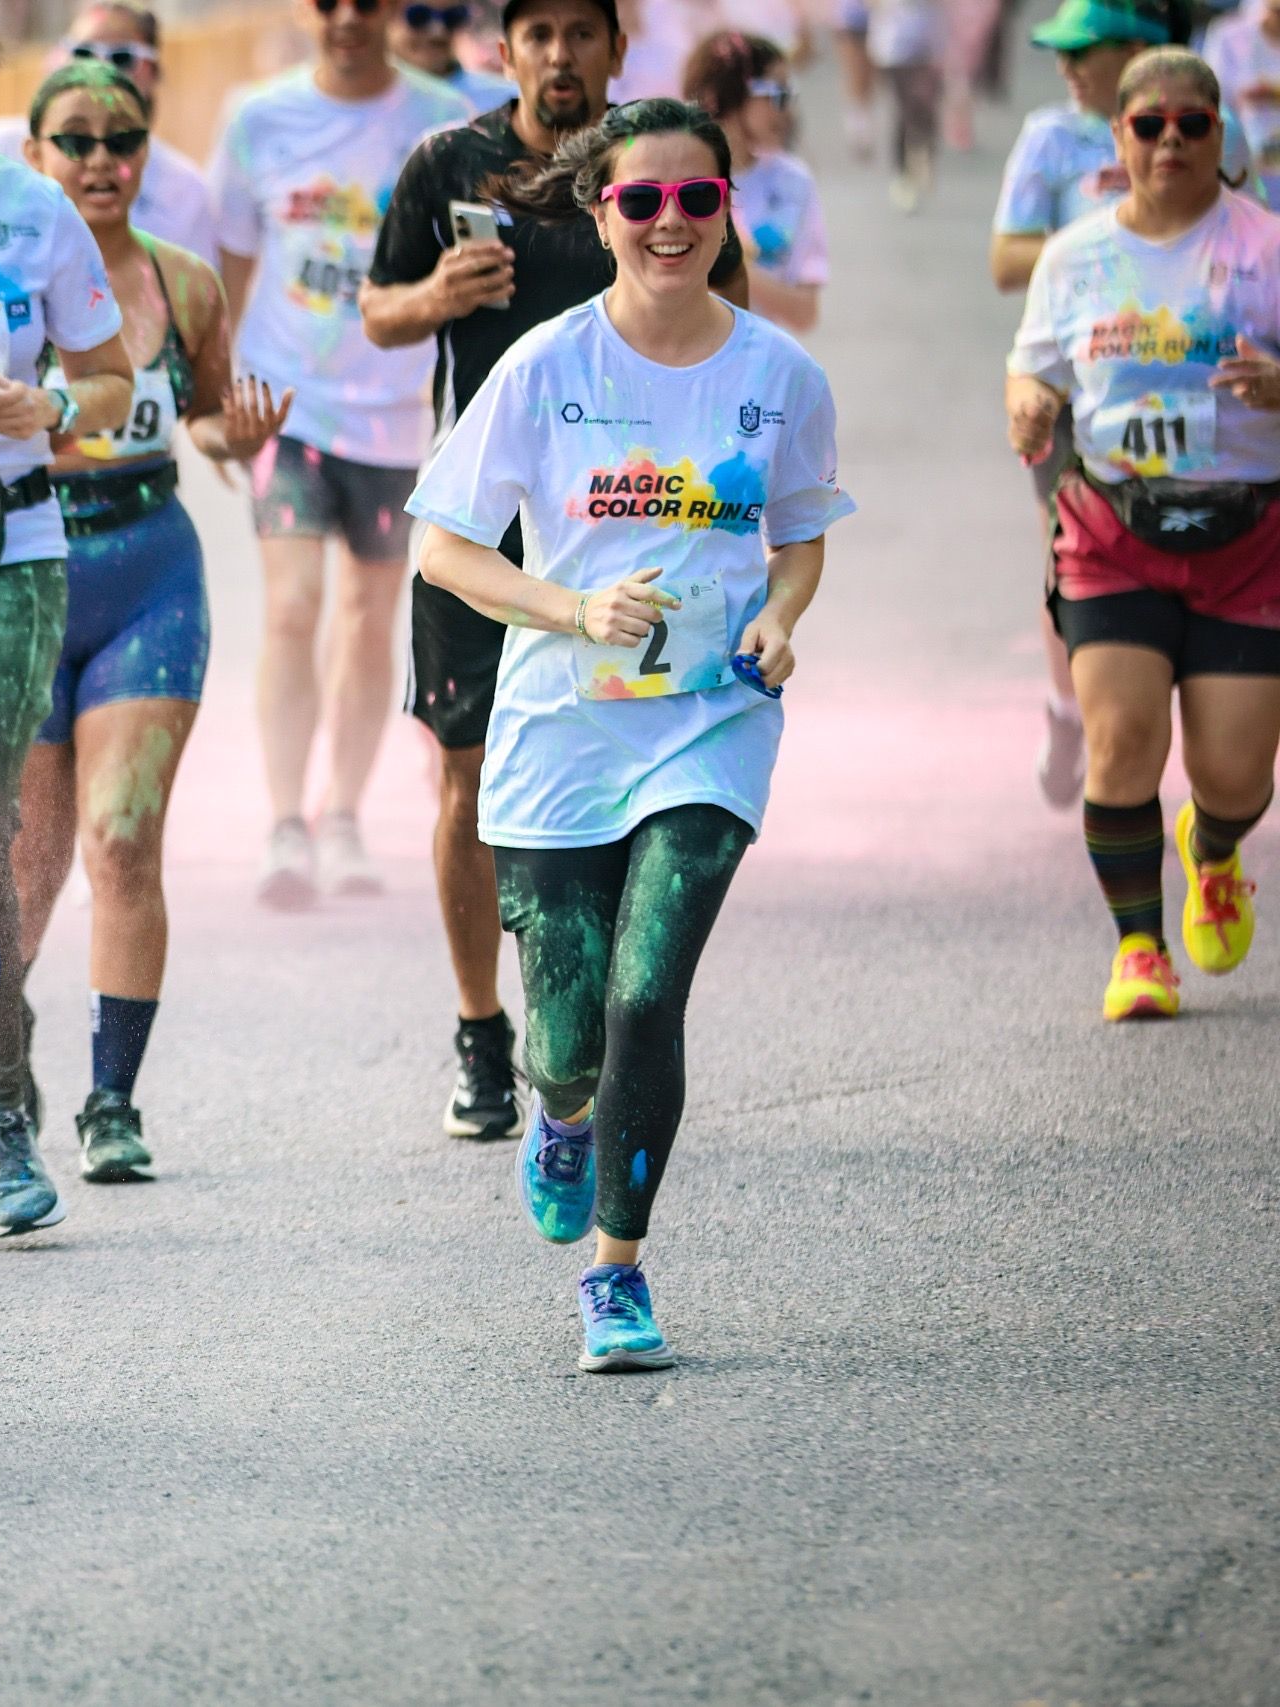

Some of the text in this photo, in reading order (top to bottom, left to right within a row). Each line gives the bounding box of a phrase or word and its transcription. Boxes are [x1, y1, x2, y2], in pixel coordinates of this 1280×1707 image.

[1122, 415, 1187, 460] 411
[588, 474, 685, 495] MAGIC
[588, 499, 682, 519] COLOR
[687, 500, 741, 521] RUN
[639, 619, 672, 676] 2
[715, 673, 723, 684] 2
